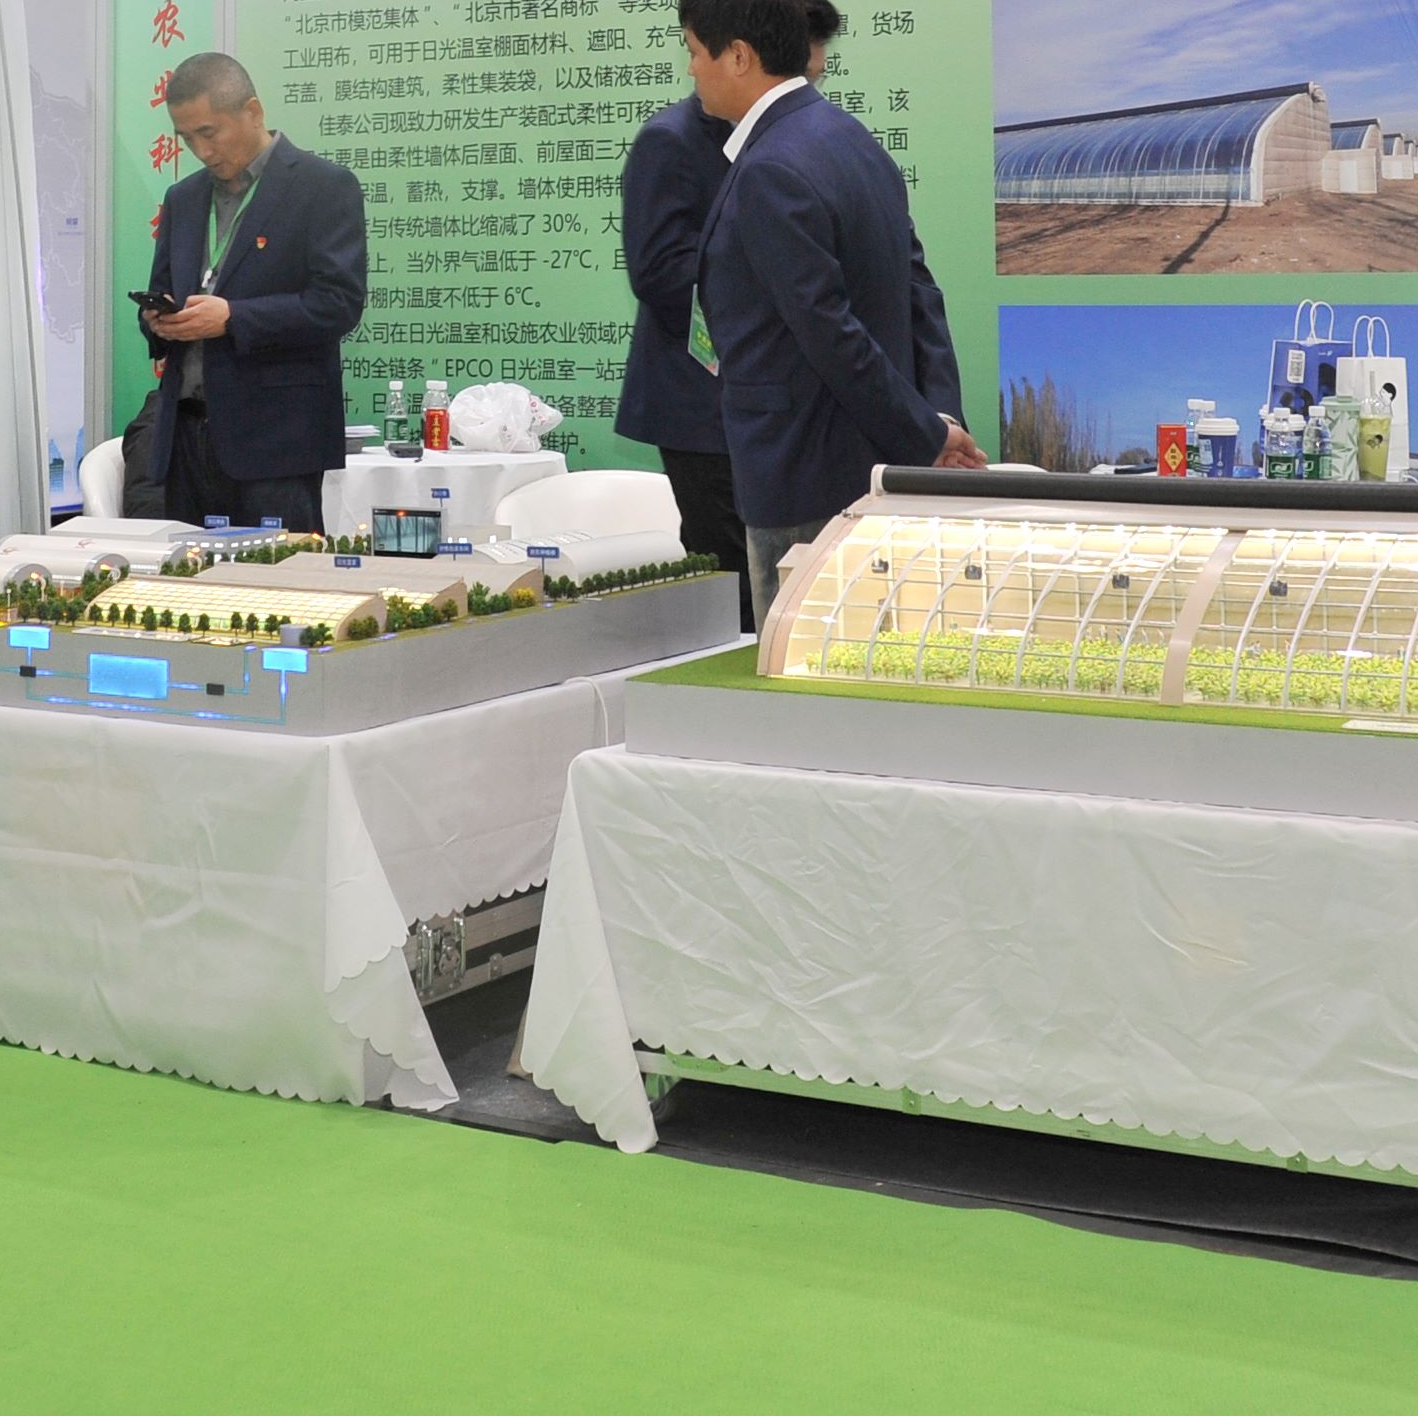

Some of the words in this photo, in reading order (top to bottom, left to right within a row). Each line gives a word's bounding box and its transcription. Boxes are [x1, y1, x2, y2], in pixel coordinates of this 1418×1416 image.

[304, 137, 632, 170] 主要是由柔性墙体后屋面、前屋面三大
[445, 359, 493, 378] EPCO
